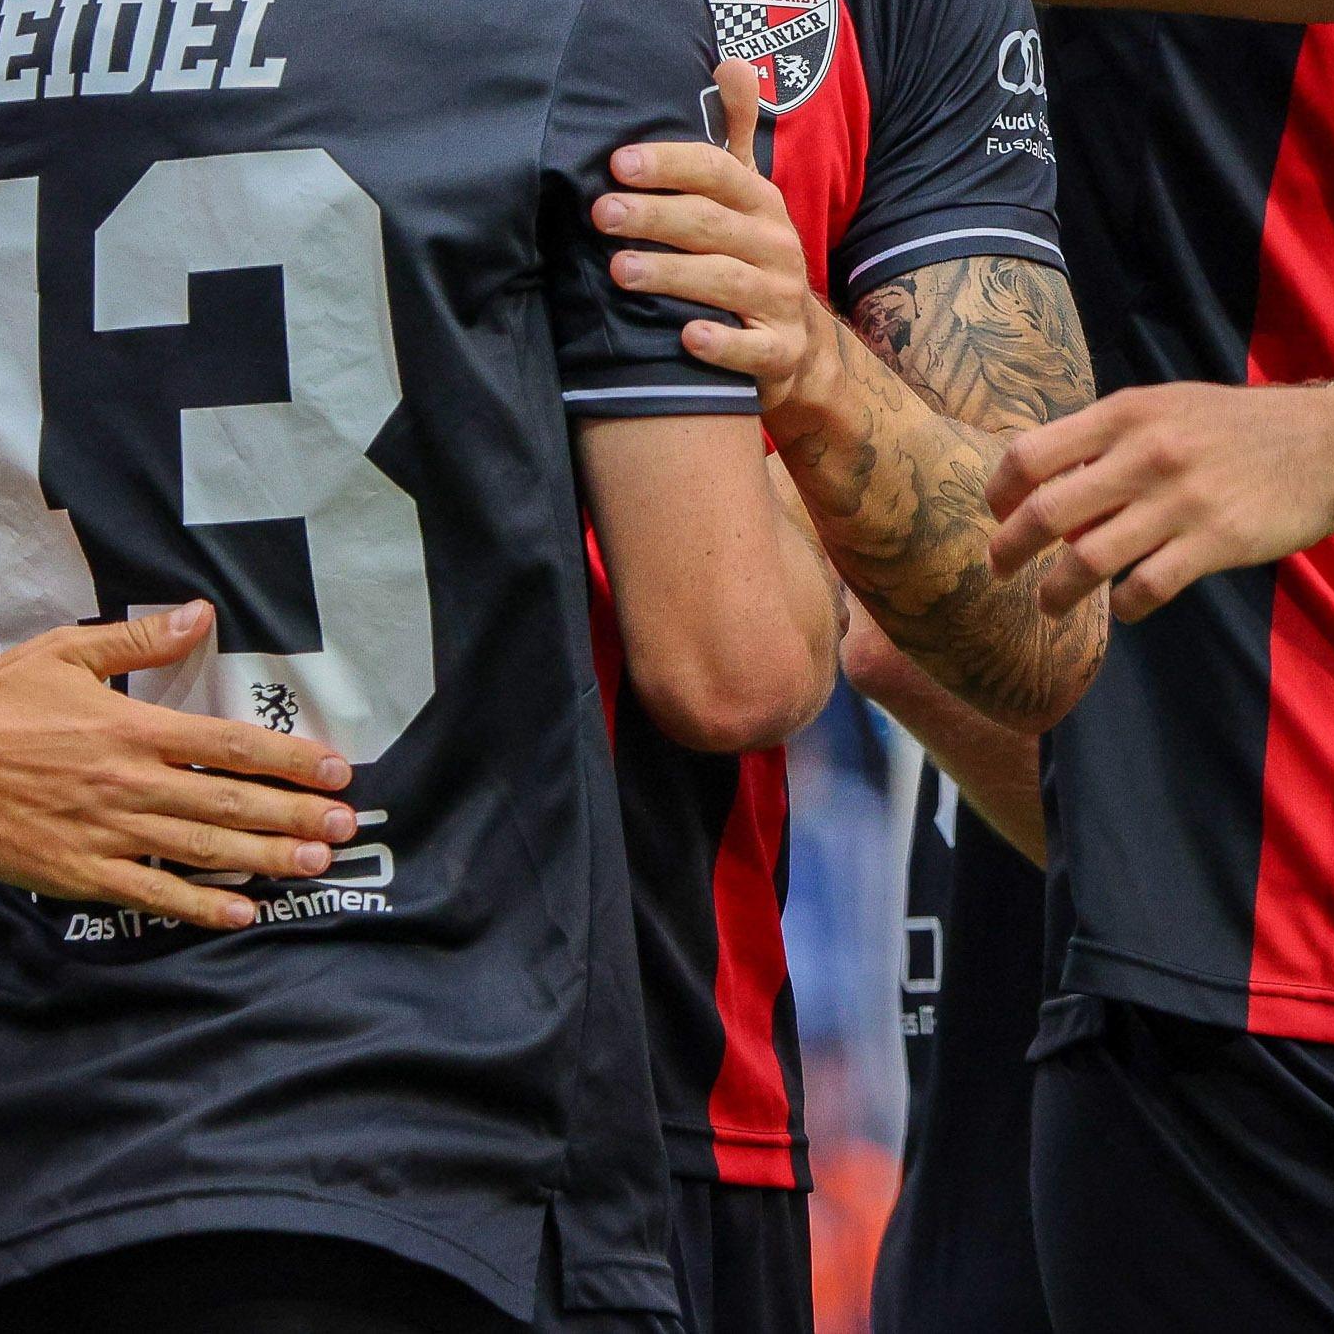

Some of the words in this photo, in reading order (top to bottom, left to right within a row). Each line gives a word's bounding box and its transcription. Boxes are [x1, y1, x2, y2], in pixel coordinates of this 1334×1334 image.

[724, 12, 826, 60] SCHANZER
[991, 112, 1036, 131] Audi
[64, 912, 115, 942] Das
